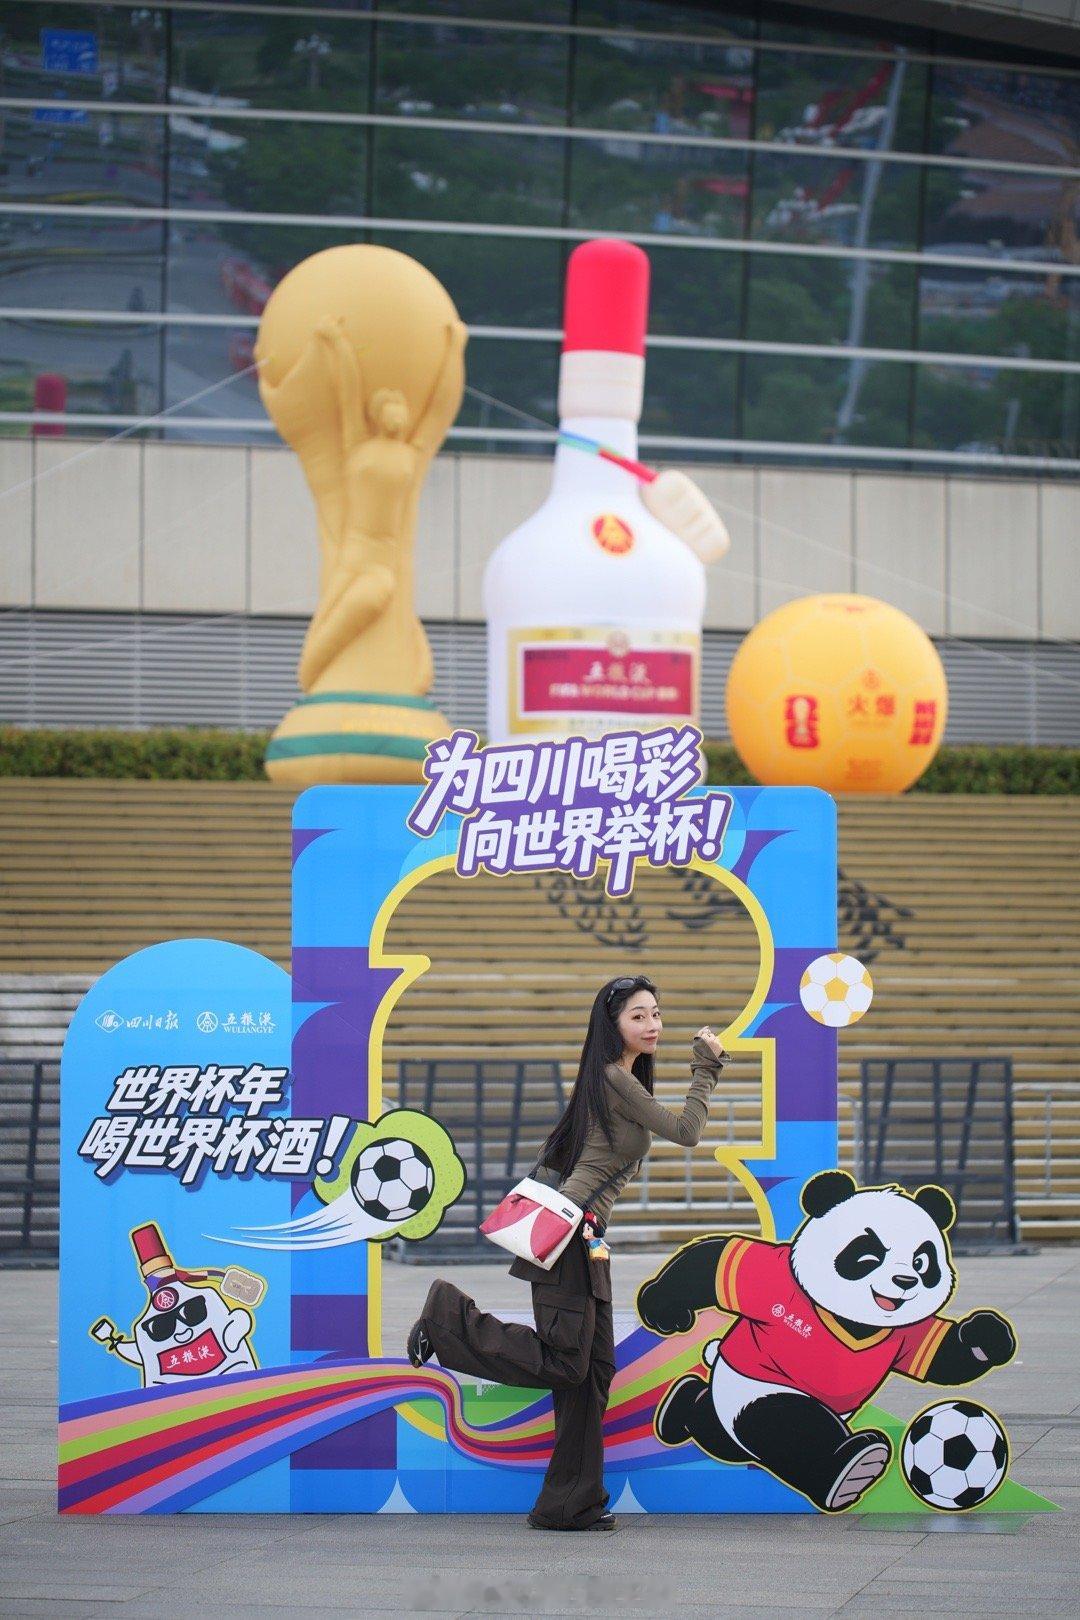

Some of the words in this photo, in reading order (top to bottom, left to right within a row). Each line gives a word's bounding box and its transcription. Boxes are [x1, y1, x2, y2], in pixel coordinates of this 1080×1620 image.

[413, 730, 696, 831] 为四川喝彩
[223, 1025, 274, 1034] WULIANGYE
[106, 1065, 288, 1115] 世界杯年
[166, 1345, 216, 1369] 五粮液
